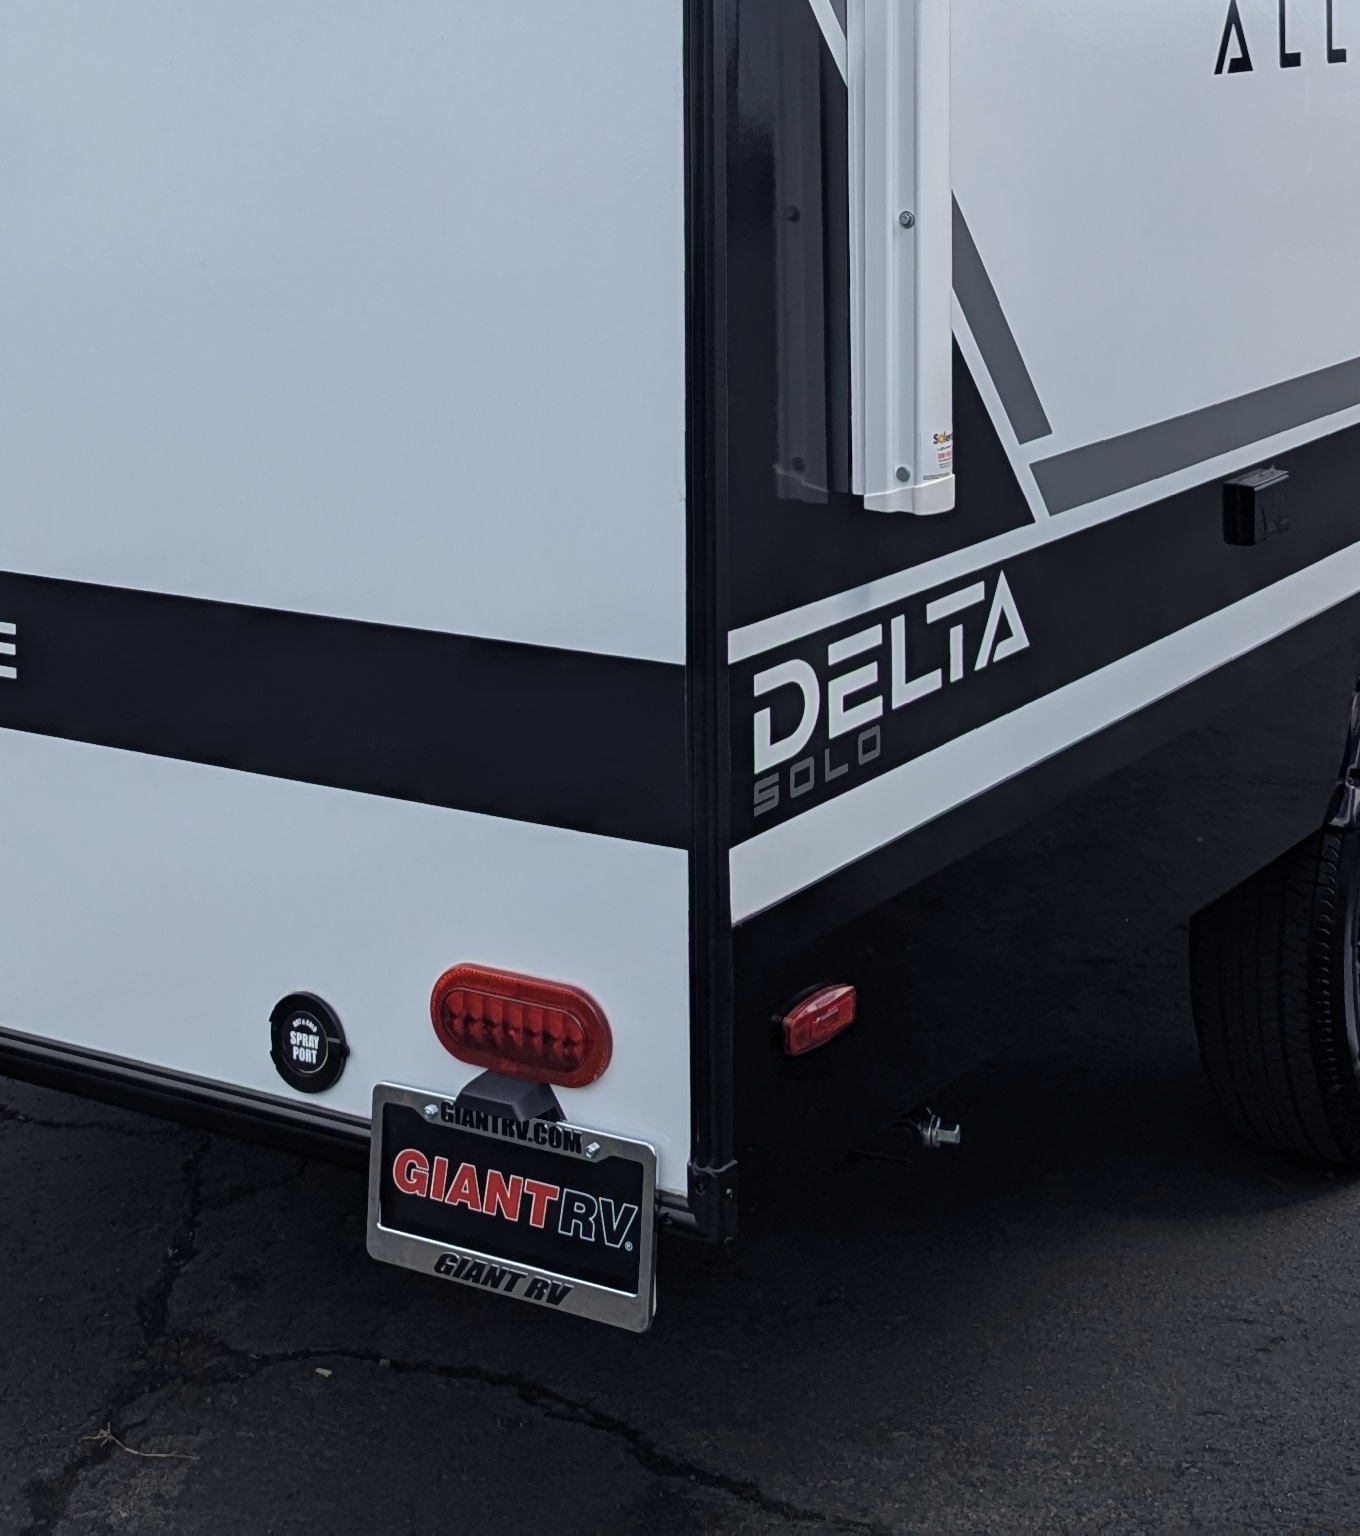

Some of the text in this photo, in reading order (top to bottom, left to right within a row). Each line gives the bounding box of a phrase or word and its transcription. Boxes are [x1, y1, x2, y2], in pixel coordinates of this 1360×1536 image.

[753, 569, 1030, 775] DELTA
[753, 724, 881, 817] SOLO
[289, 1030, 320, 1049] SPRAY
[292, 1046, 317, 1064] PORT
[440, 1100, 582, 1154] GIANTRV.COM
[433, 1251, 574, 1306] GIANT RV
